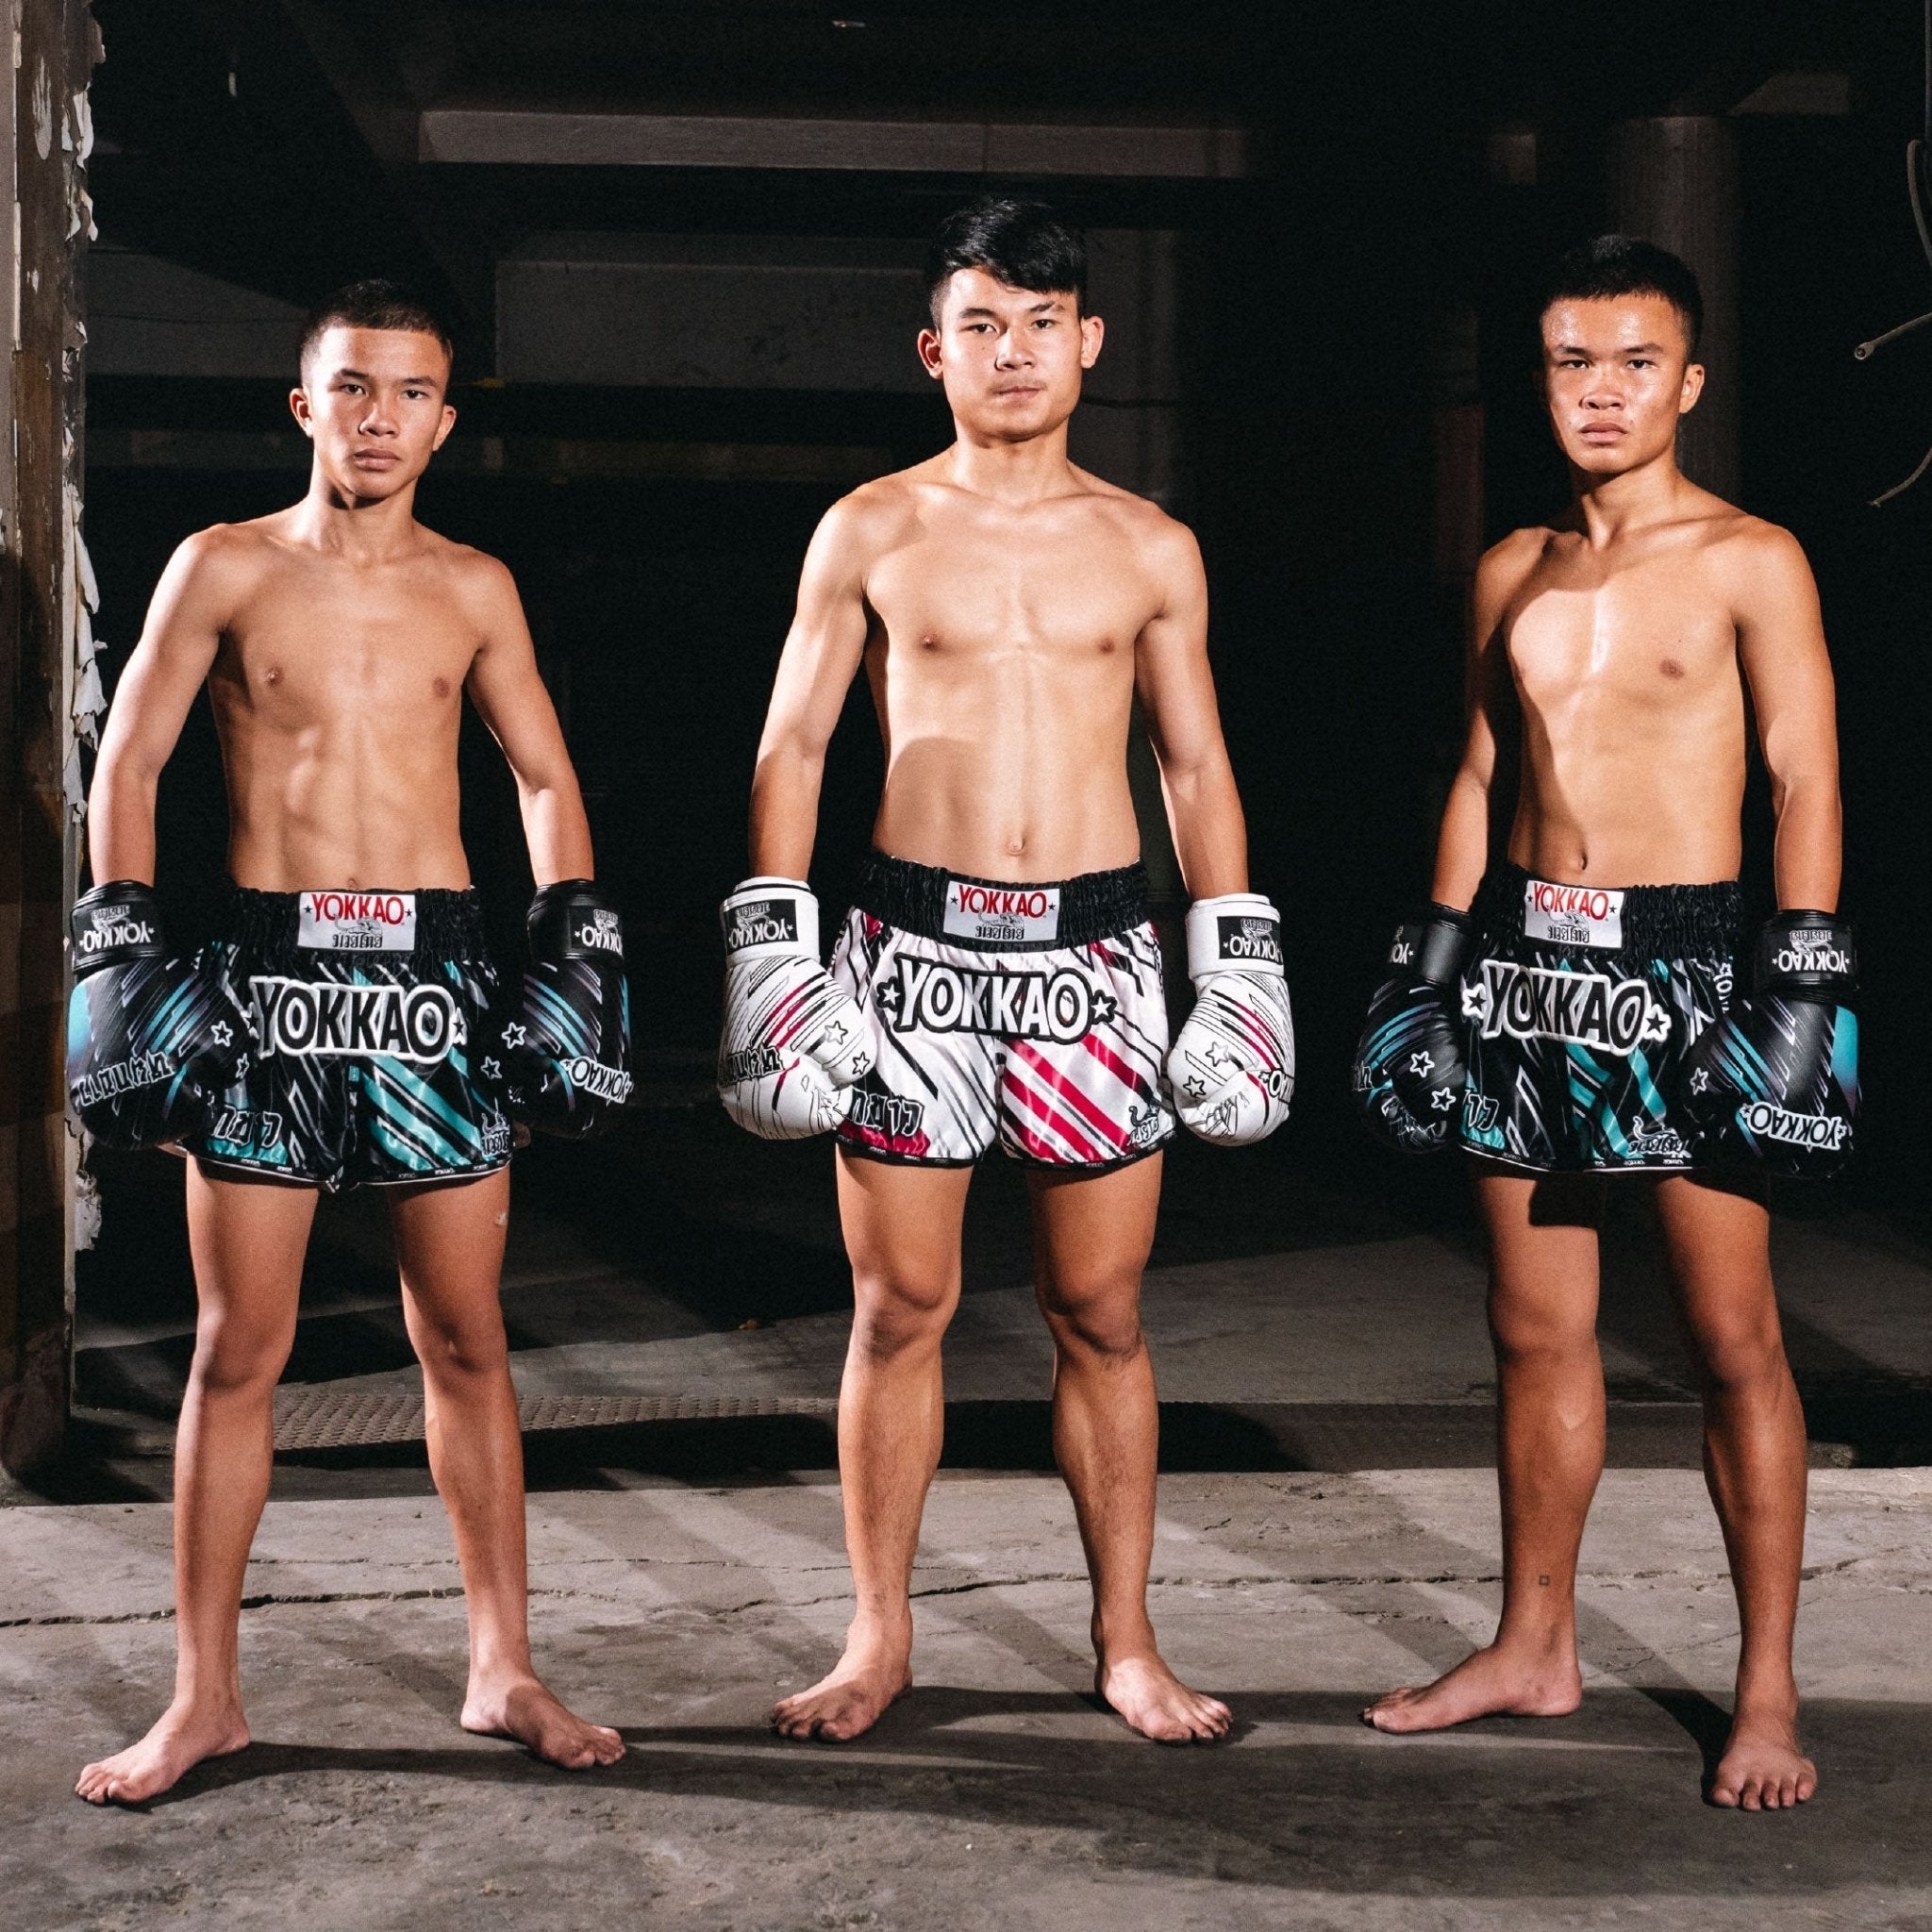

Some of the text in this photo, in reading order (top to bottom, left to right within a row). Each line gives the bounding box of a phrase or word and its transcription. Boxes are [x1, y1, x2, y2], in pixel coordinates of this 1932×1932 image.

[311, 893, 406, 924] YOKKAO
[958, 885, 1047, 918] YOKKAO
[1533, 884, 1609, 921] YOKKAO
[83, 921, 152, 953] YOKKAO
[730, 918, 788, 949] YOKKAO
[1778, 948, 1848, 974] YOKKAO
[894, 953, 1092, 1045] YOKKAO
[1481, 958, 1650, 1057] YOKKAO
[249, 975, 455, 1064] YOKKAO
[570, 1056, 629, 1104] YOKKAO
[1749, 1100, 1843, 1152] YOKKAO
